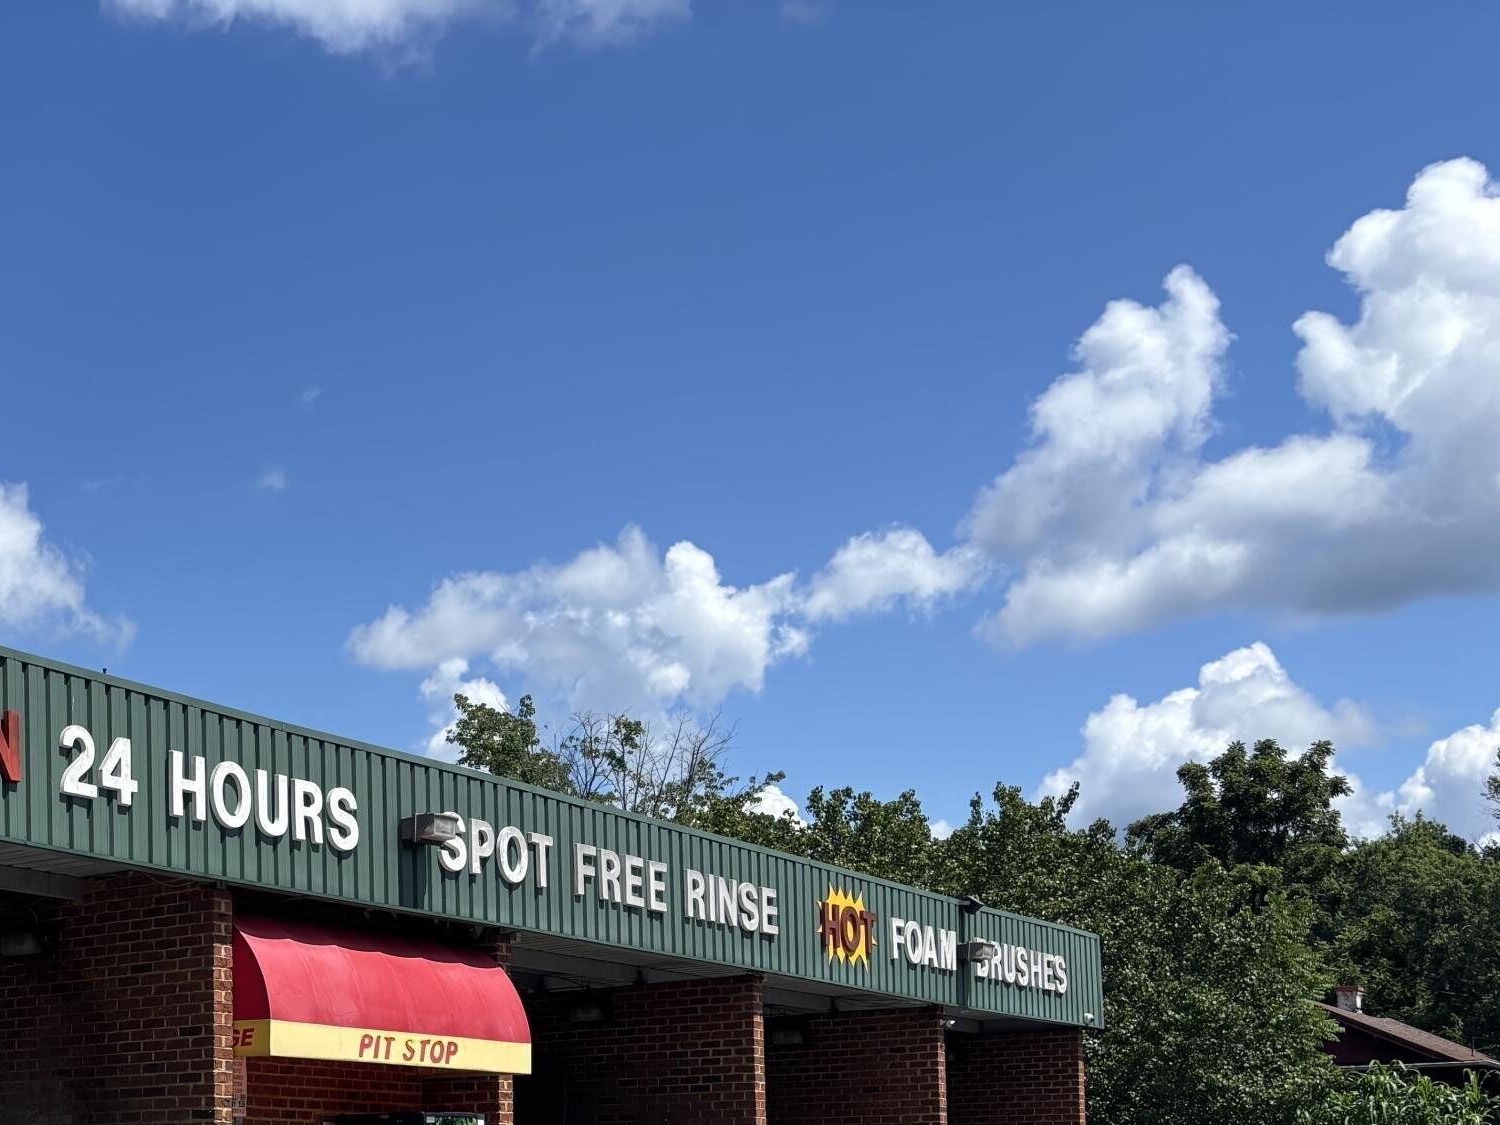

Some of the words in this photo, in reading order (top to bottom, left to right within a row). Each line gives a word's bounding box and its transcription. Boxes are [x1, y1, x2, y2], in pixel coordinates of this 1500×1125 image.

[58, 724, 138, 807] 24
[167, 749, 359, 852] HOURS
[437, 811, 553, 888] SPOT
[574, 843, 667, 912] FREE
[684, 868, 778, 935] RINSE
[820, 902, 876, 956] HOT
[891, 917, 956, 971] FOAM
[359, 1034, 395, 1059] PIT
[403, 1039, 458, 1064] STOP
